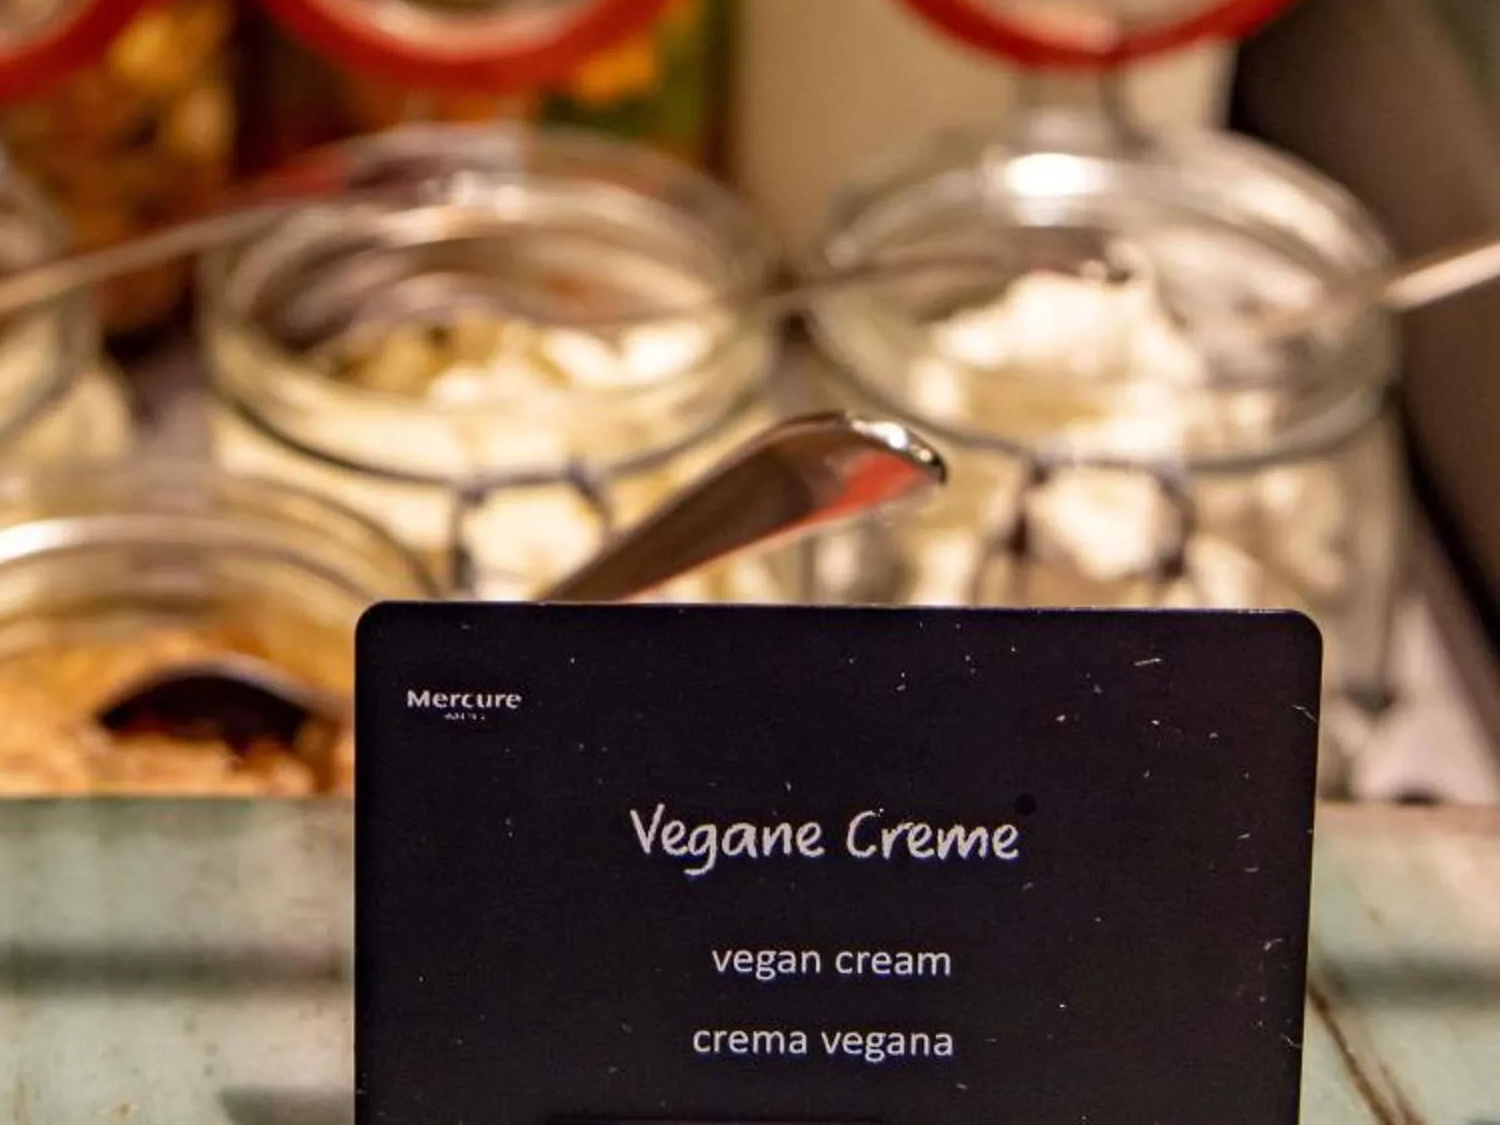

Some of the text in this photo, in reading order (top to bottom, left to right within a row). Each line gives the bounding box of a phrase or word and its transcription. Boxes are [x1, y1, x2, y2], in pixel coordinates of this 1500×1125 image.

[406, 689, 522, 709] Mercure
[629, 803, 1020, 876] Vegane Creme
[711, 949, 952, 981] vegan cream
[692, 1030, 954, 1063] crema vegana
